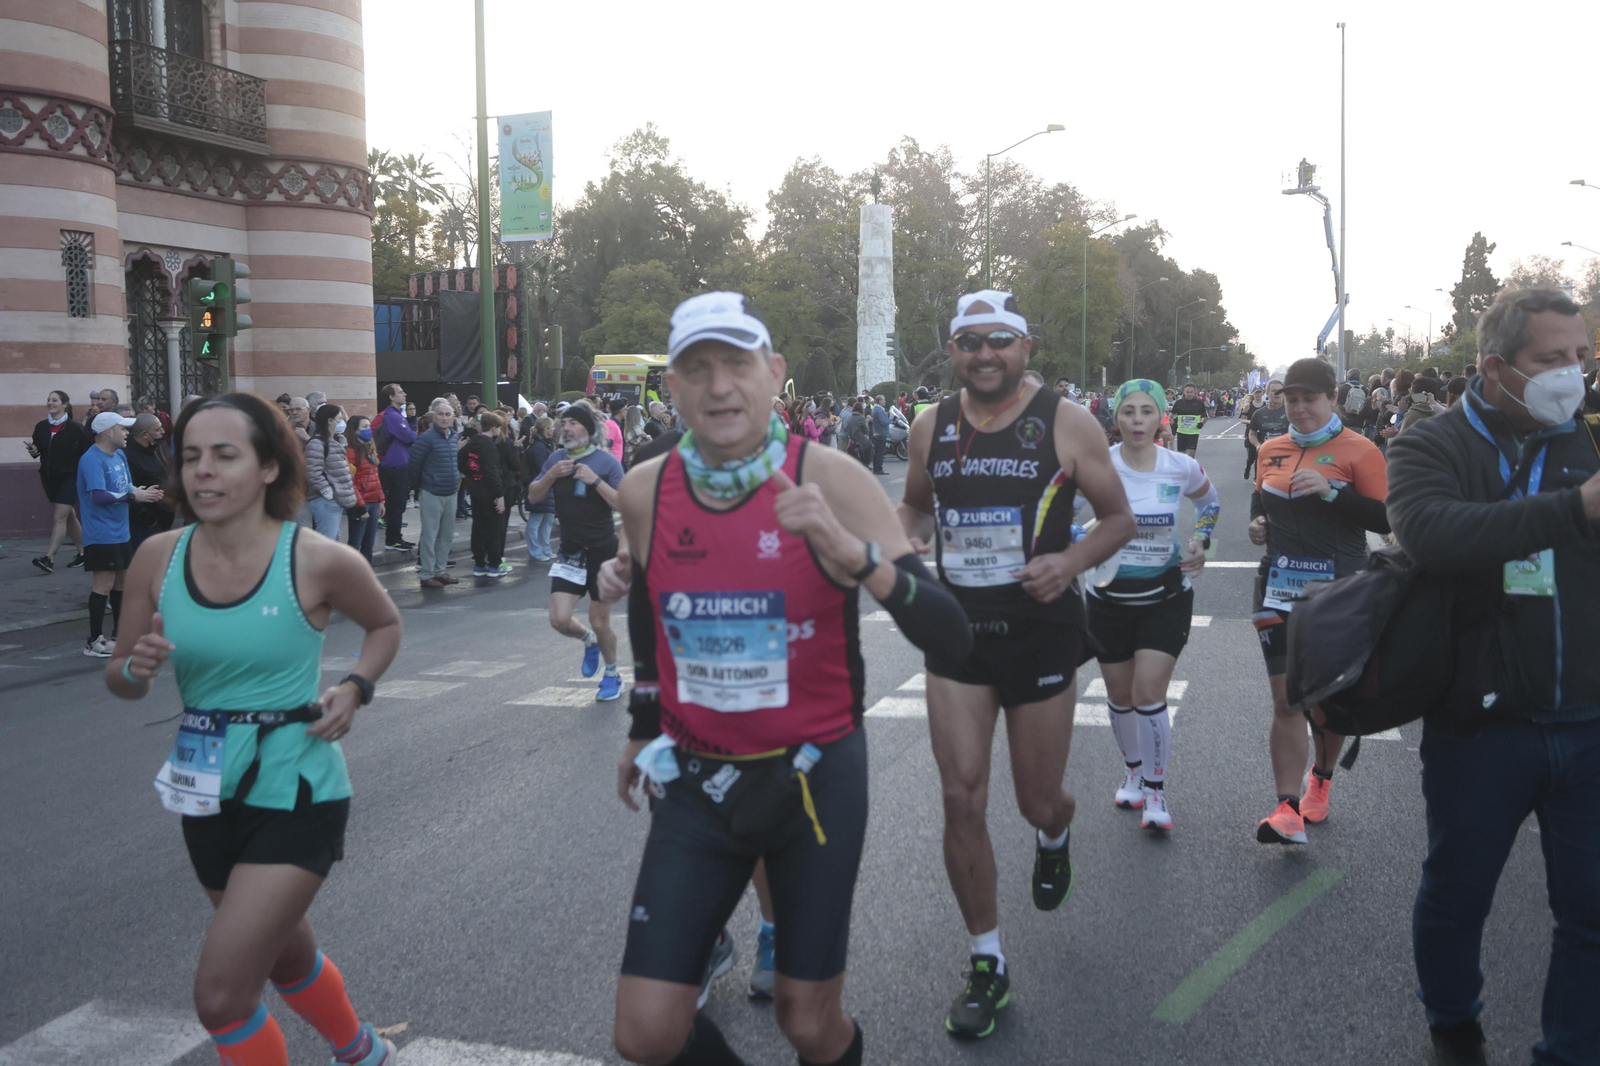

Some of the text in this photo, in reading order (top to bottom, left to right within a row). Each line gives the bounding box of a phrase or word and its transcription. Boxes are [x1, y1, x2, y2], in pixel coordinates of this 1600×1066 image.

[933, 458, 1039, 479] LOS JARTIBLES
[962, 511, 1011, 524] ZURICH
[1136, 516, 1169, 525] ZURICH
[965, 537, 992, 549] 9460
[1289, 560, 1327, 571] ZURICH
[694, 598, 769, 616] ZURICH
